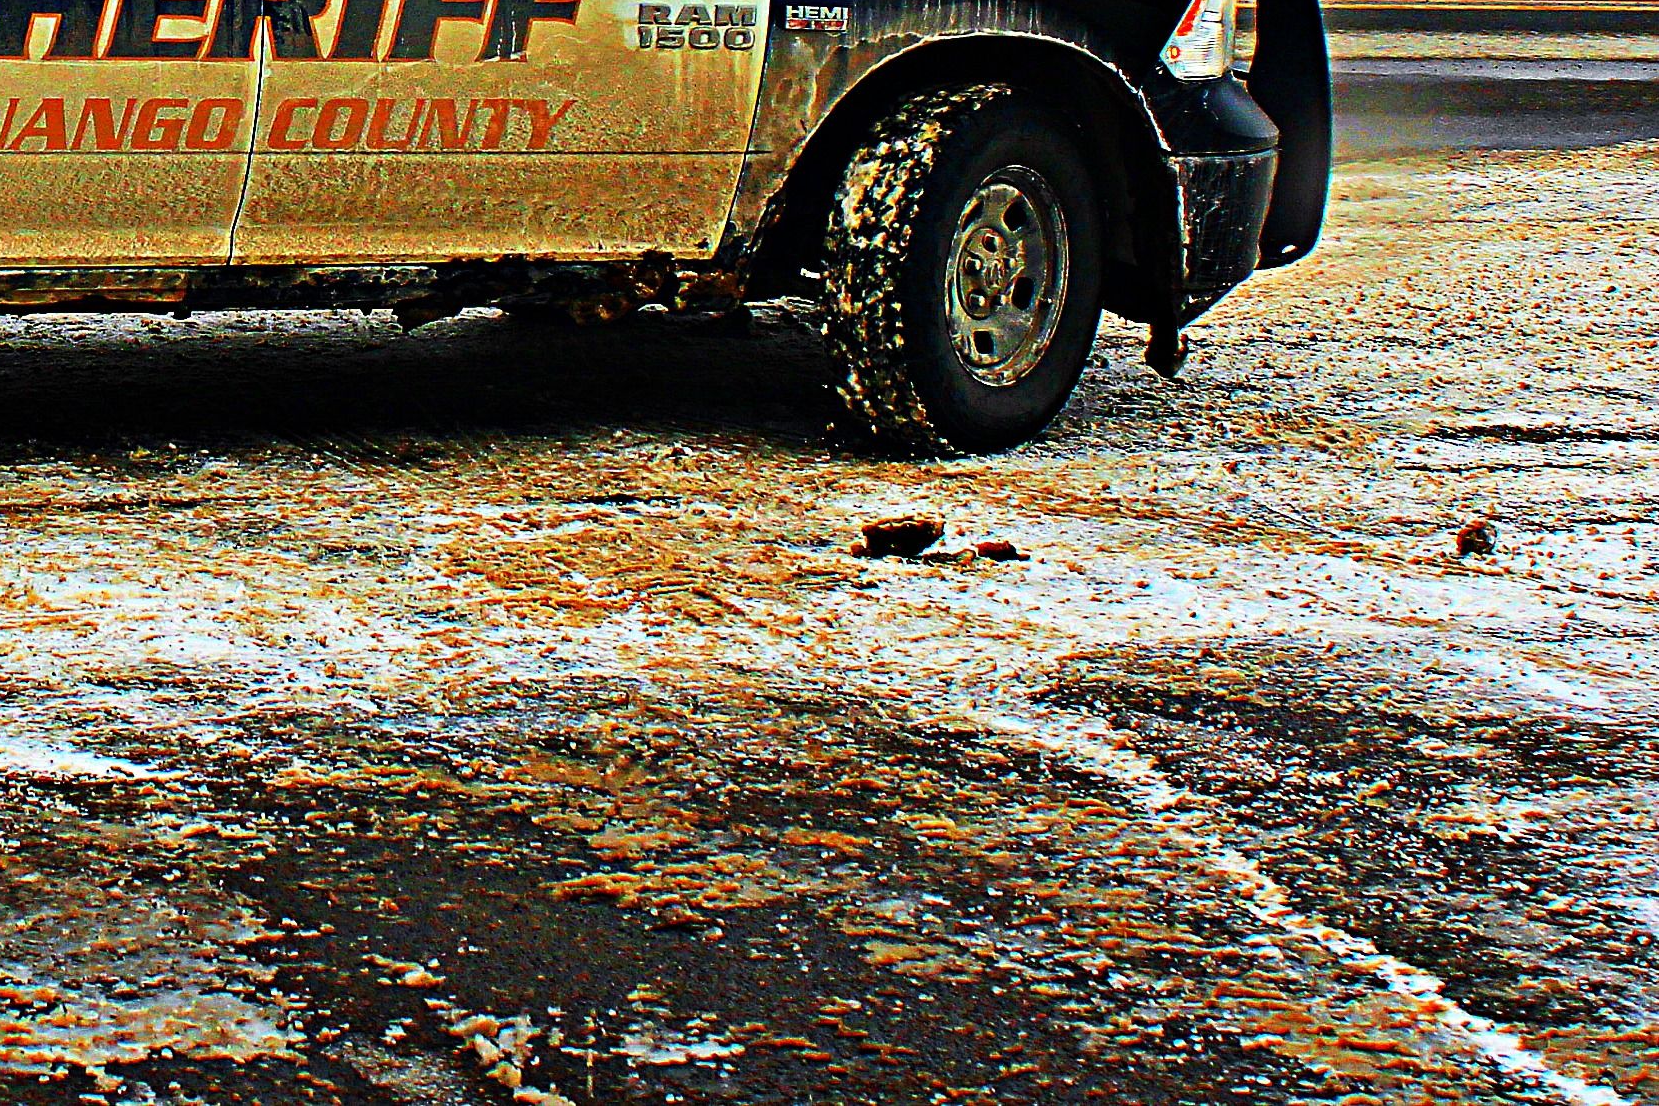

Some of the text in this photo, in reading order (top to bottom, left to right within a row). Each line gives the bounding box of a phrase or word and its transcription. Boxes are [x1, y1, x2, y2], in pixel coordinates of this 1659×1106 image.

[638, 3, 757, 26] RAM
[786, 5, 849, 20] HEMI
[638, 26, 756, 50] 1500
[267, 98, 578, 151] COUNTY
